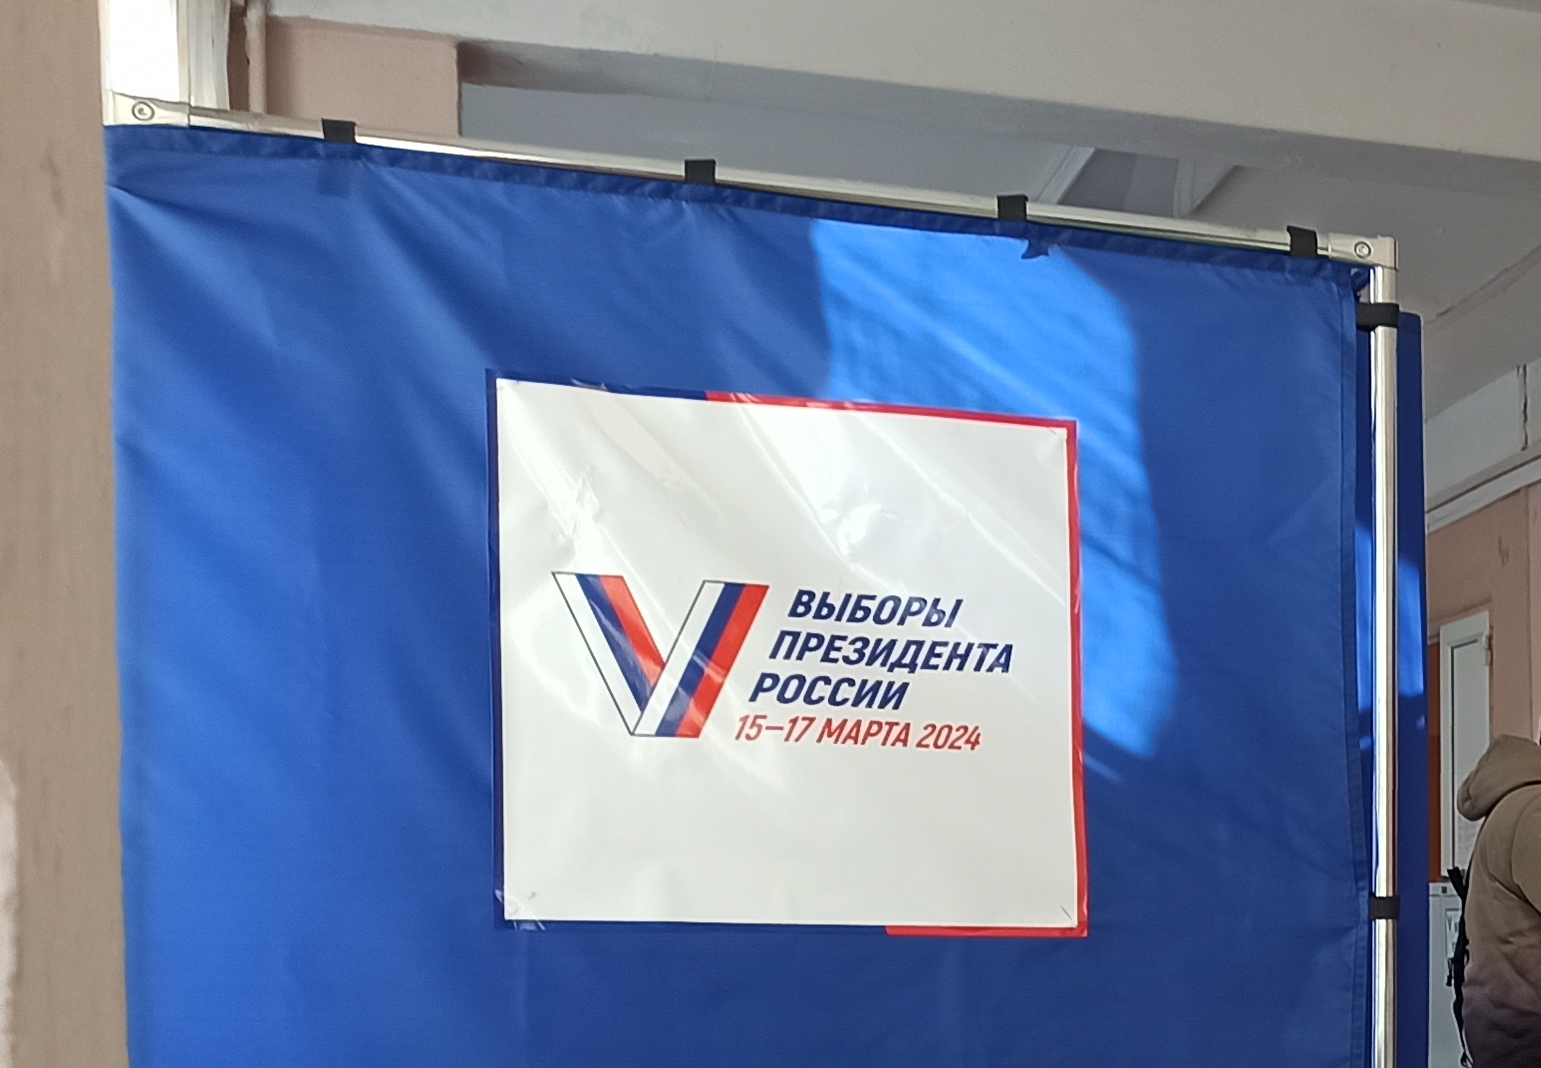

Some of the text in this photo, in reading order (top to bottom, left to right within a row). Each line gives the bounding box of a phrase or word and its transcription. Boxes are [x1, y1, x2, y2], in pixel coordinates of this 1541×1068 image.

[787, 588, 964, 628] ВЫБОРЫ
[768, 630, 1013, 674] ПРЕЗИДЕНТА
[748, 671, 910, 711] РОССИИ
[816, 722, 911, 748] МАРТА
[915, 723, 981, 751] 2024
